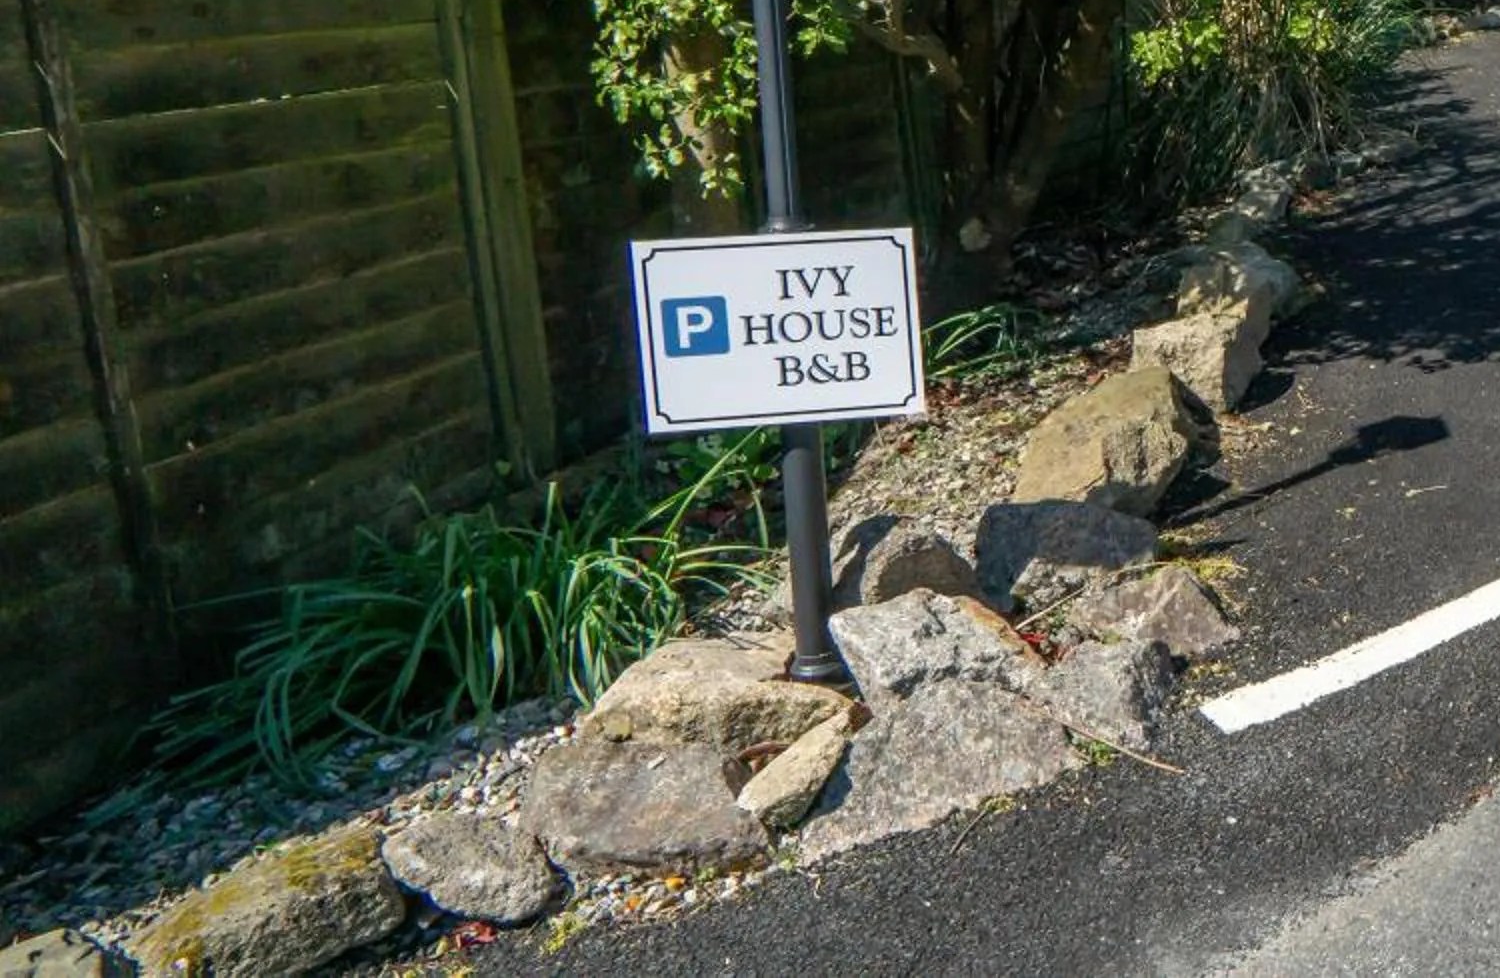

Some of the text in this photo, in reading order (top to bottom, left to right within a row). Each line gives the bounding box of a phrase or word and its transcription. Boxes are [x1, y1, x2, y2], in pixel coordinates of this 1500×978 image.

[775, 265, 855, 301] IVY
[676, 306, 714, 349] P
[739, 305, 899, 346] HOUSE
[775, 351, 872, 387] B&B
